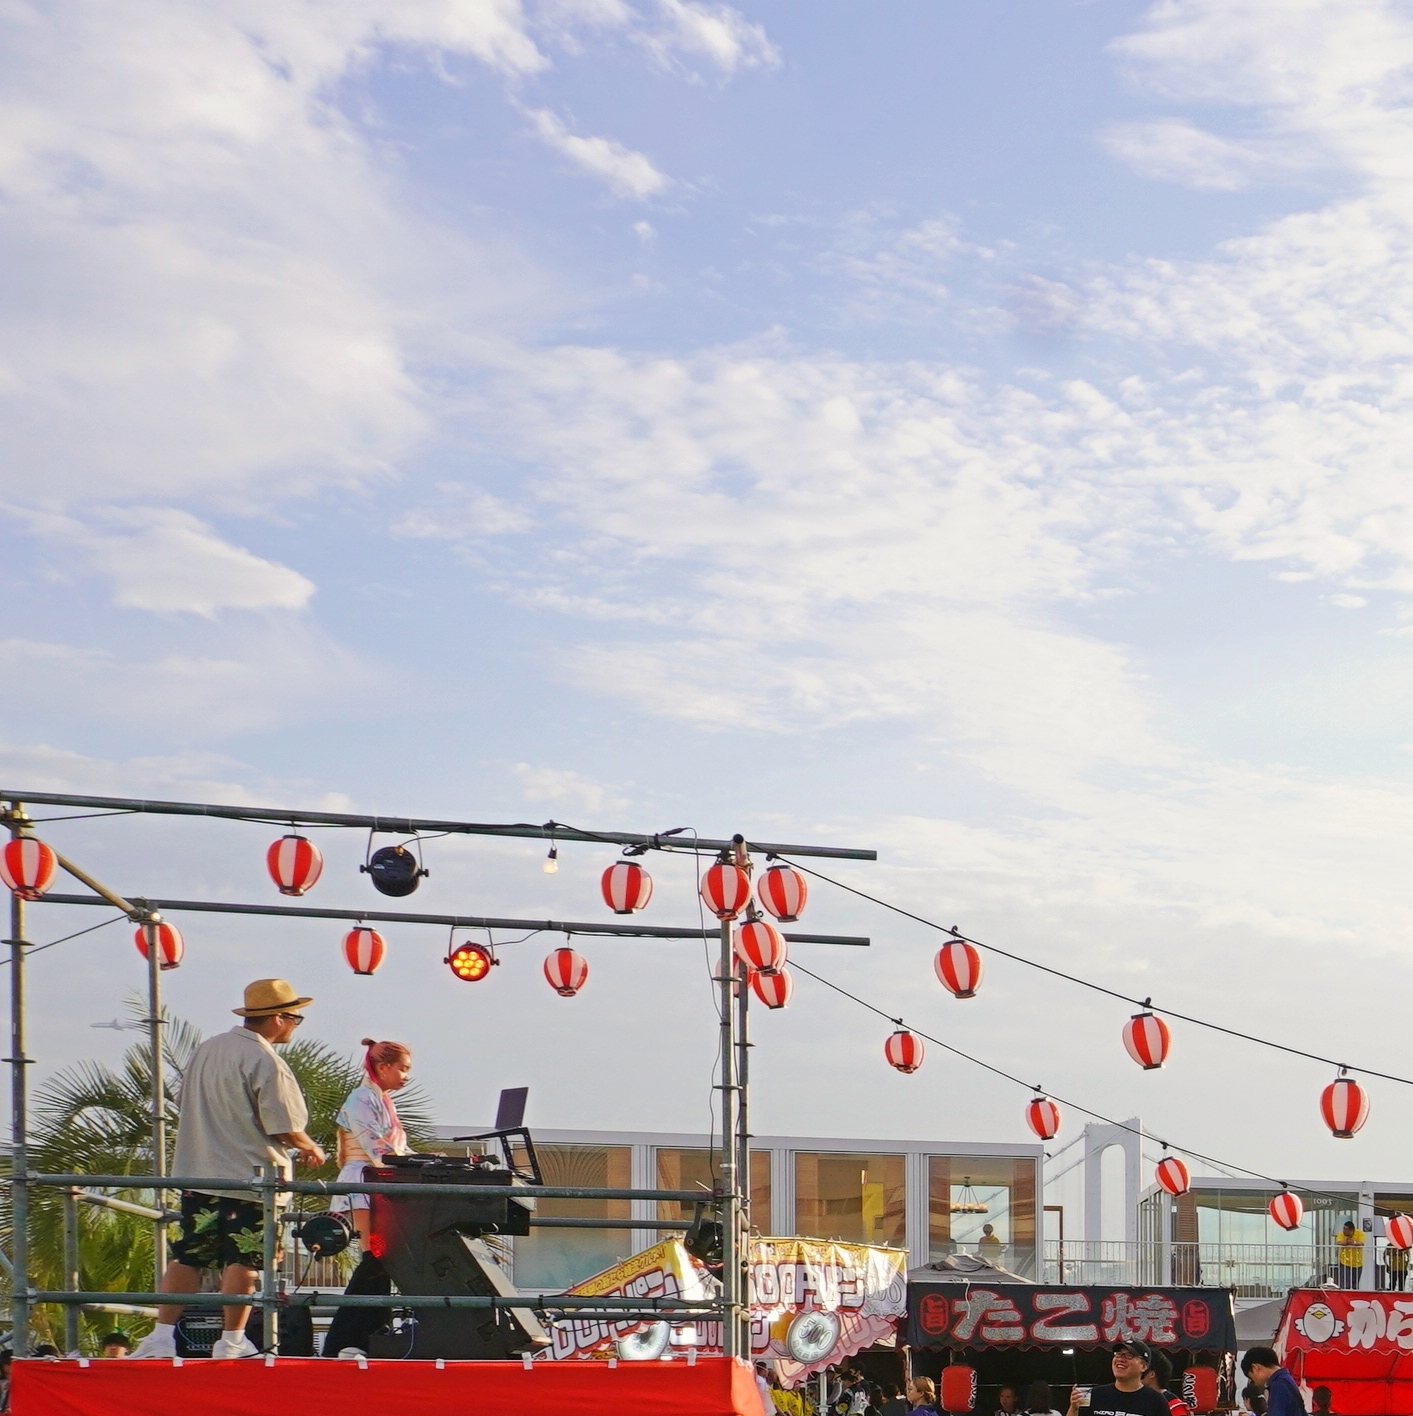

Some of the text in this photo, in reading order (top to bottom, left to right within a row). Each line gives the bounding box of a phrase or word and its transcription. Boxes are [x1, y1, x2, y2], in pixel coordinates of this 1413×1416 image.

[1313, 1197, 1333, 1207] 1003
[952, 1289, 1180, 1344] たこ焼
